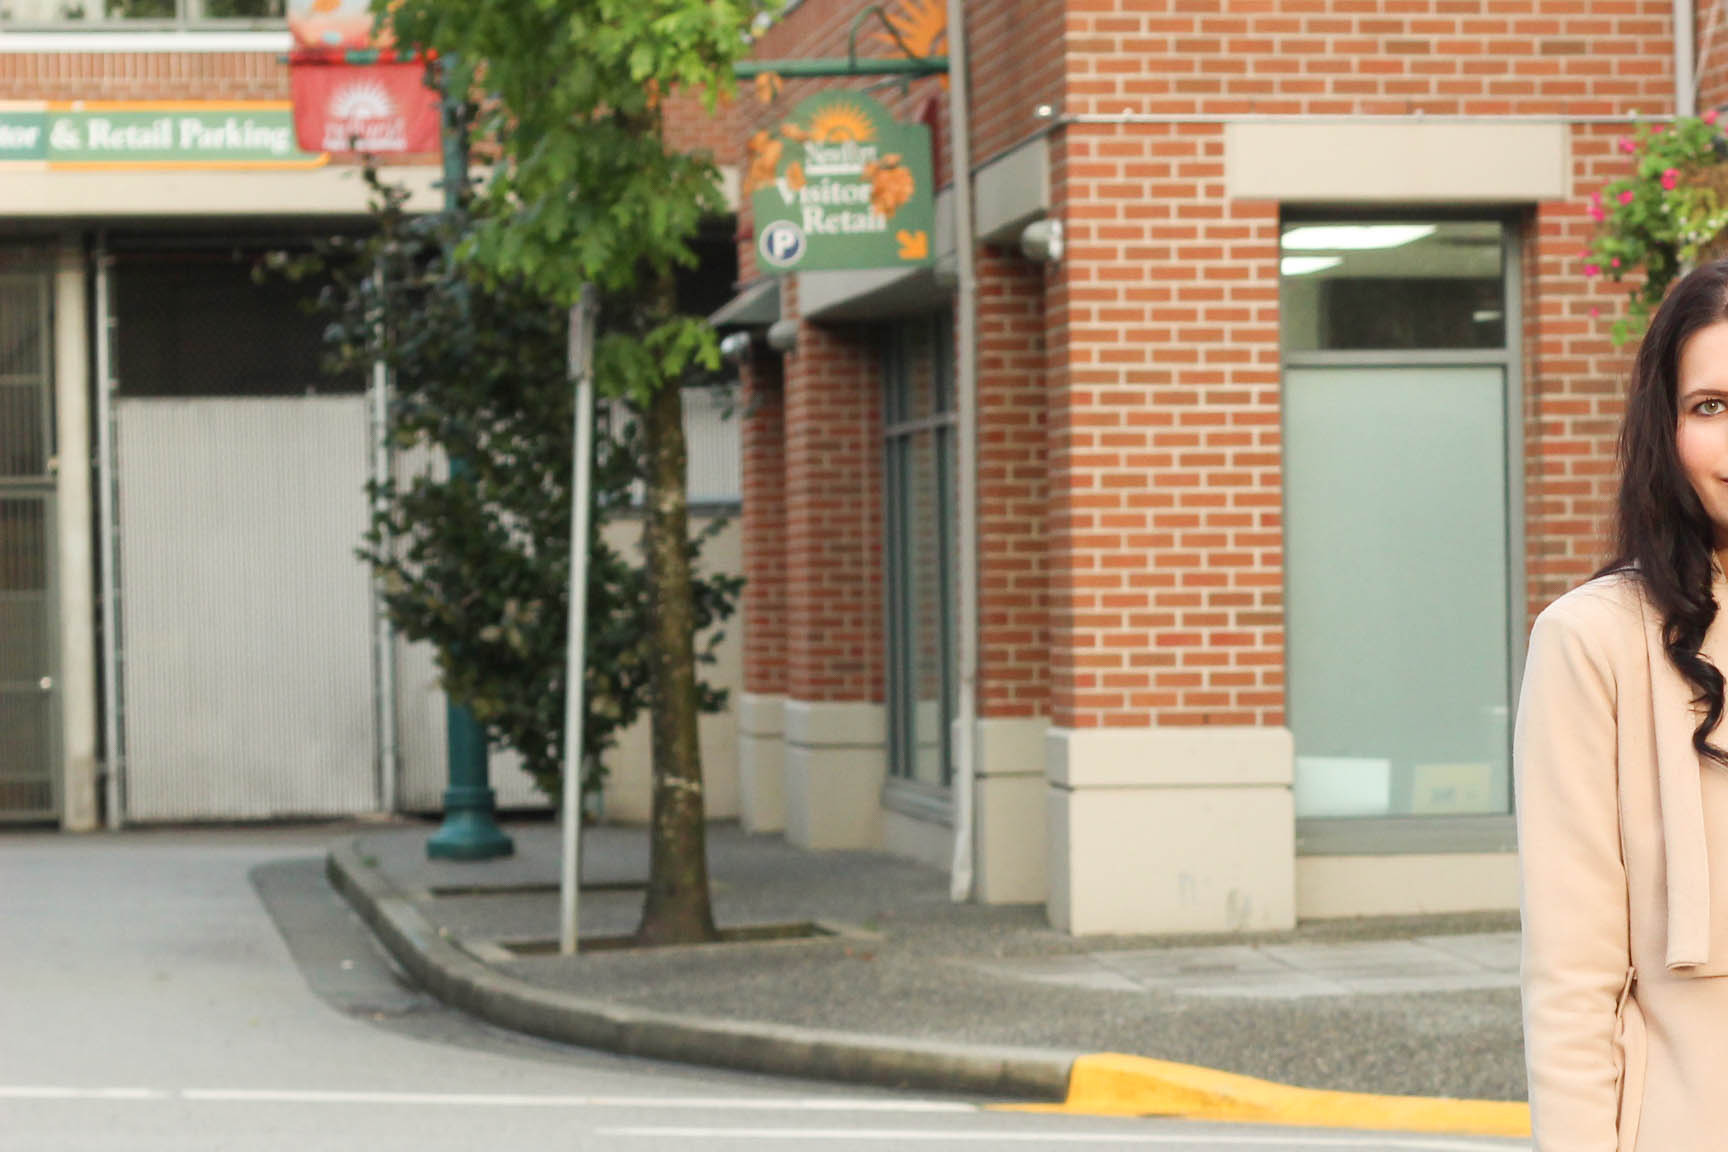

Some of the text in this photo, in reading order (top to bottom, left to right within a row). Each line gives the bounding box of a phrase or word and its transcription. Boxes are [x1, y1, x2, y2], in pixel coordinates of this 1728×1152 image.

[49, 117, 82, 151] &
[87, 117, 173, 150] Retail
[179, 117, 290, 156] Parking
[803, 203, 887, 234] Retail
